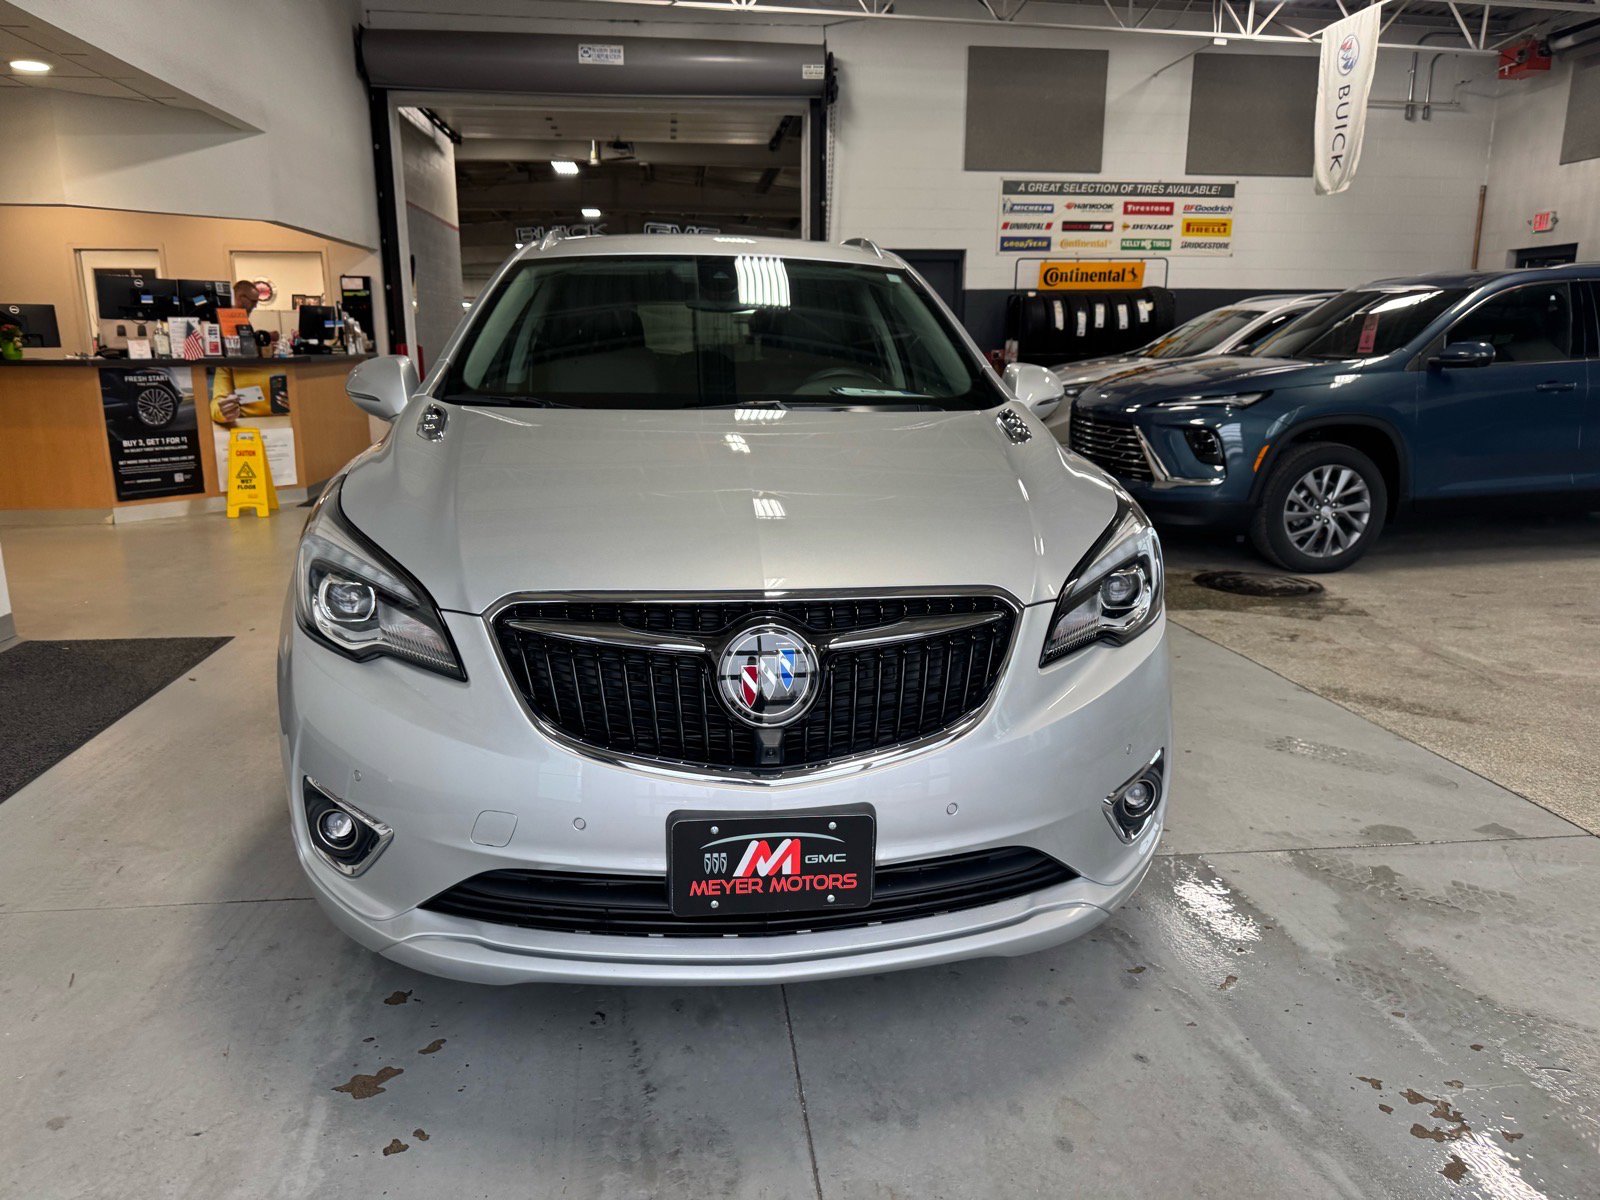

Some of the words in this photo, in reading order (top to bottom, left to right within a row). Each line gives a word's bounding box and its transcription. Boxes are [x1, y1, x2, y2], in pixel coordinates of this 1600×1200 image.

[1330, 85, 1350, 172] BUICK
[1018, 184, 1025, 192] A
[1028, 184, 1061, 192] GREAT
[1063, 184, 1118, 193] SELECTION
[1121, 184, 1134, 193] OF
[1137, 184, 1164, 194] TIRES
[1166, 185, 1221, 195] AVAILABLE!
[516, 223, 608, 241] BUICK
[1186, 222, 1227, 233] PIRELLI
[1003, 239, 1048, 249] GOODYEAR
[1060, 239, 1108, 249] Continental
[1180, 241, 1230, 249] BRIDGESTONE
[1044, 267, 1126, 287] Continental
[146, 438, 160, 446] GET
[166, 437, 180, 445] FOR
[805, 853, 846, 863] GMC
[689, 877, 763, 897] MEYER
[769, 873, 857, 893] MOTORS
